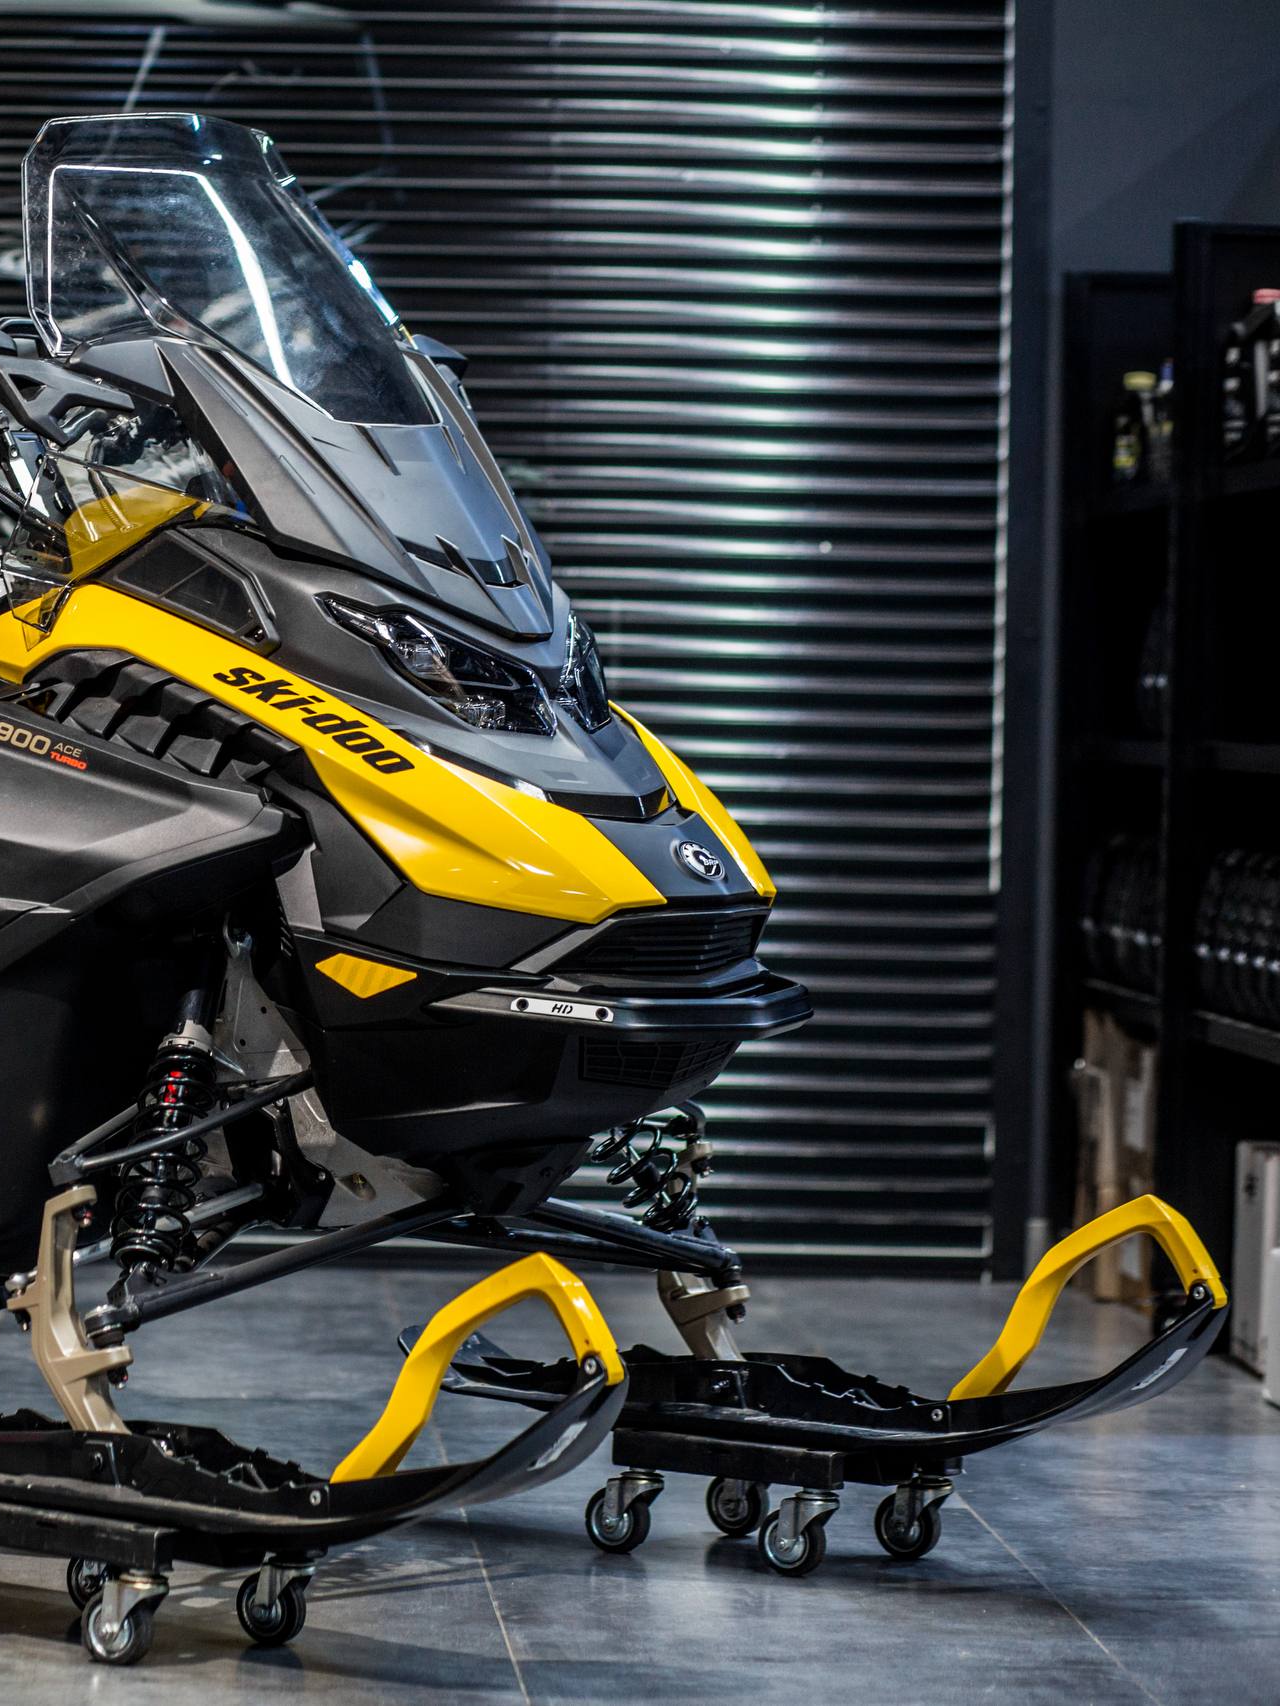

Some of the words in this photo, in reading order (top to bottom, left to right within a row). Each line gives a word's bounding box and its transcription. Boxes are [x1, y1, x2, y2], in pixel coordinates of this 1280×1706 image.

[53, 742, 82, 758] ACE
[50, 751, 87, 770] TURBO
[551, 1003, 574, 1015] HD
